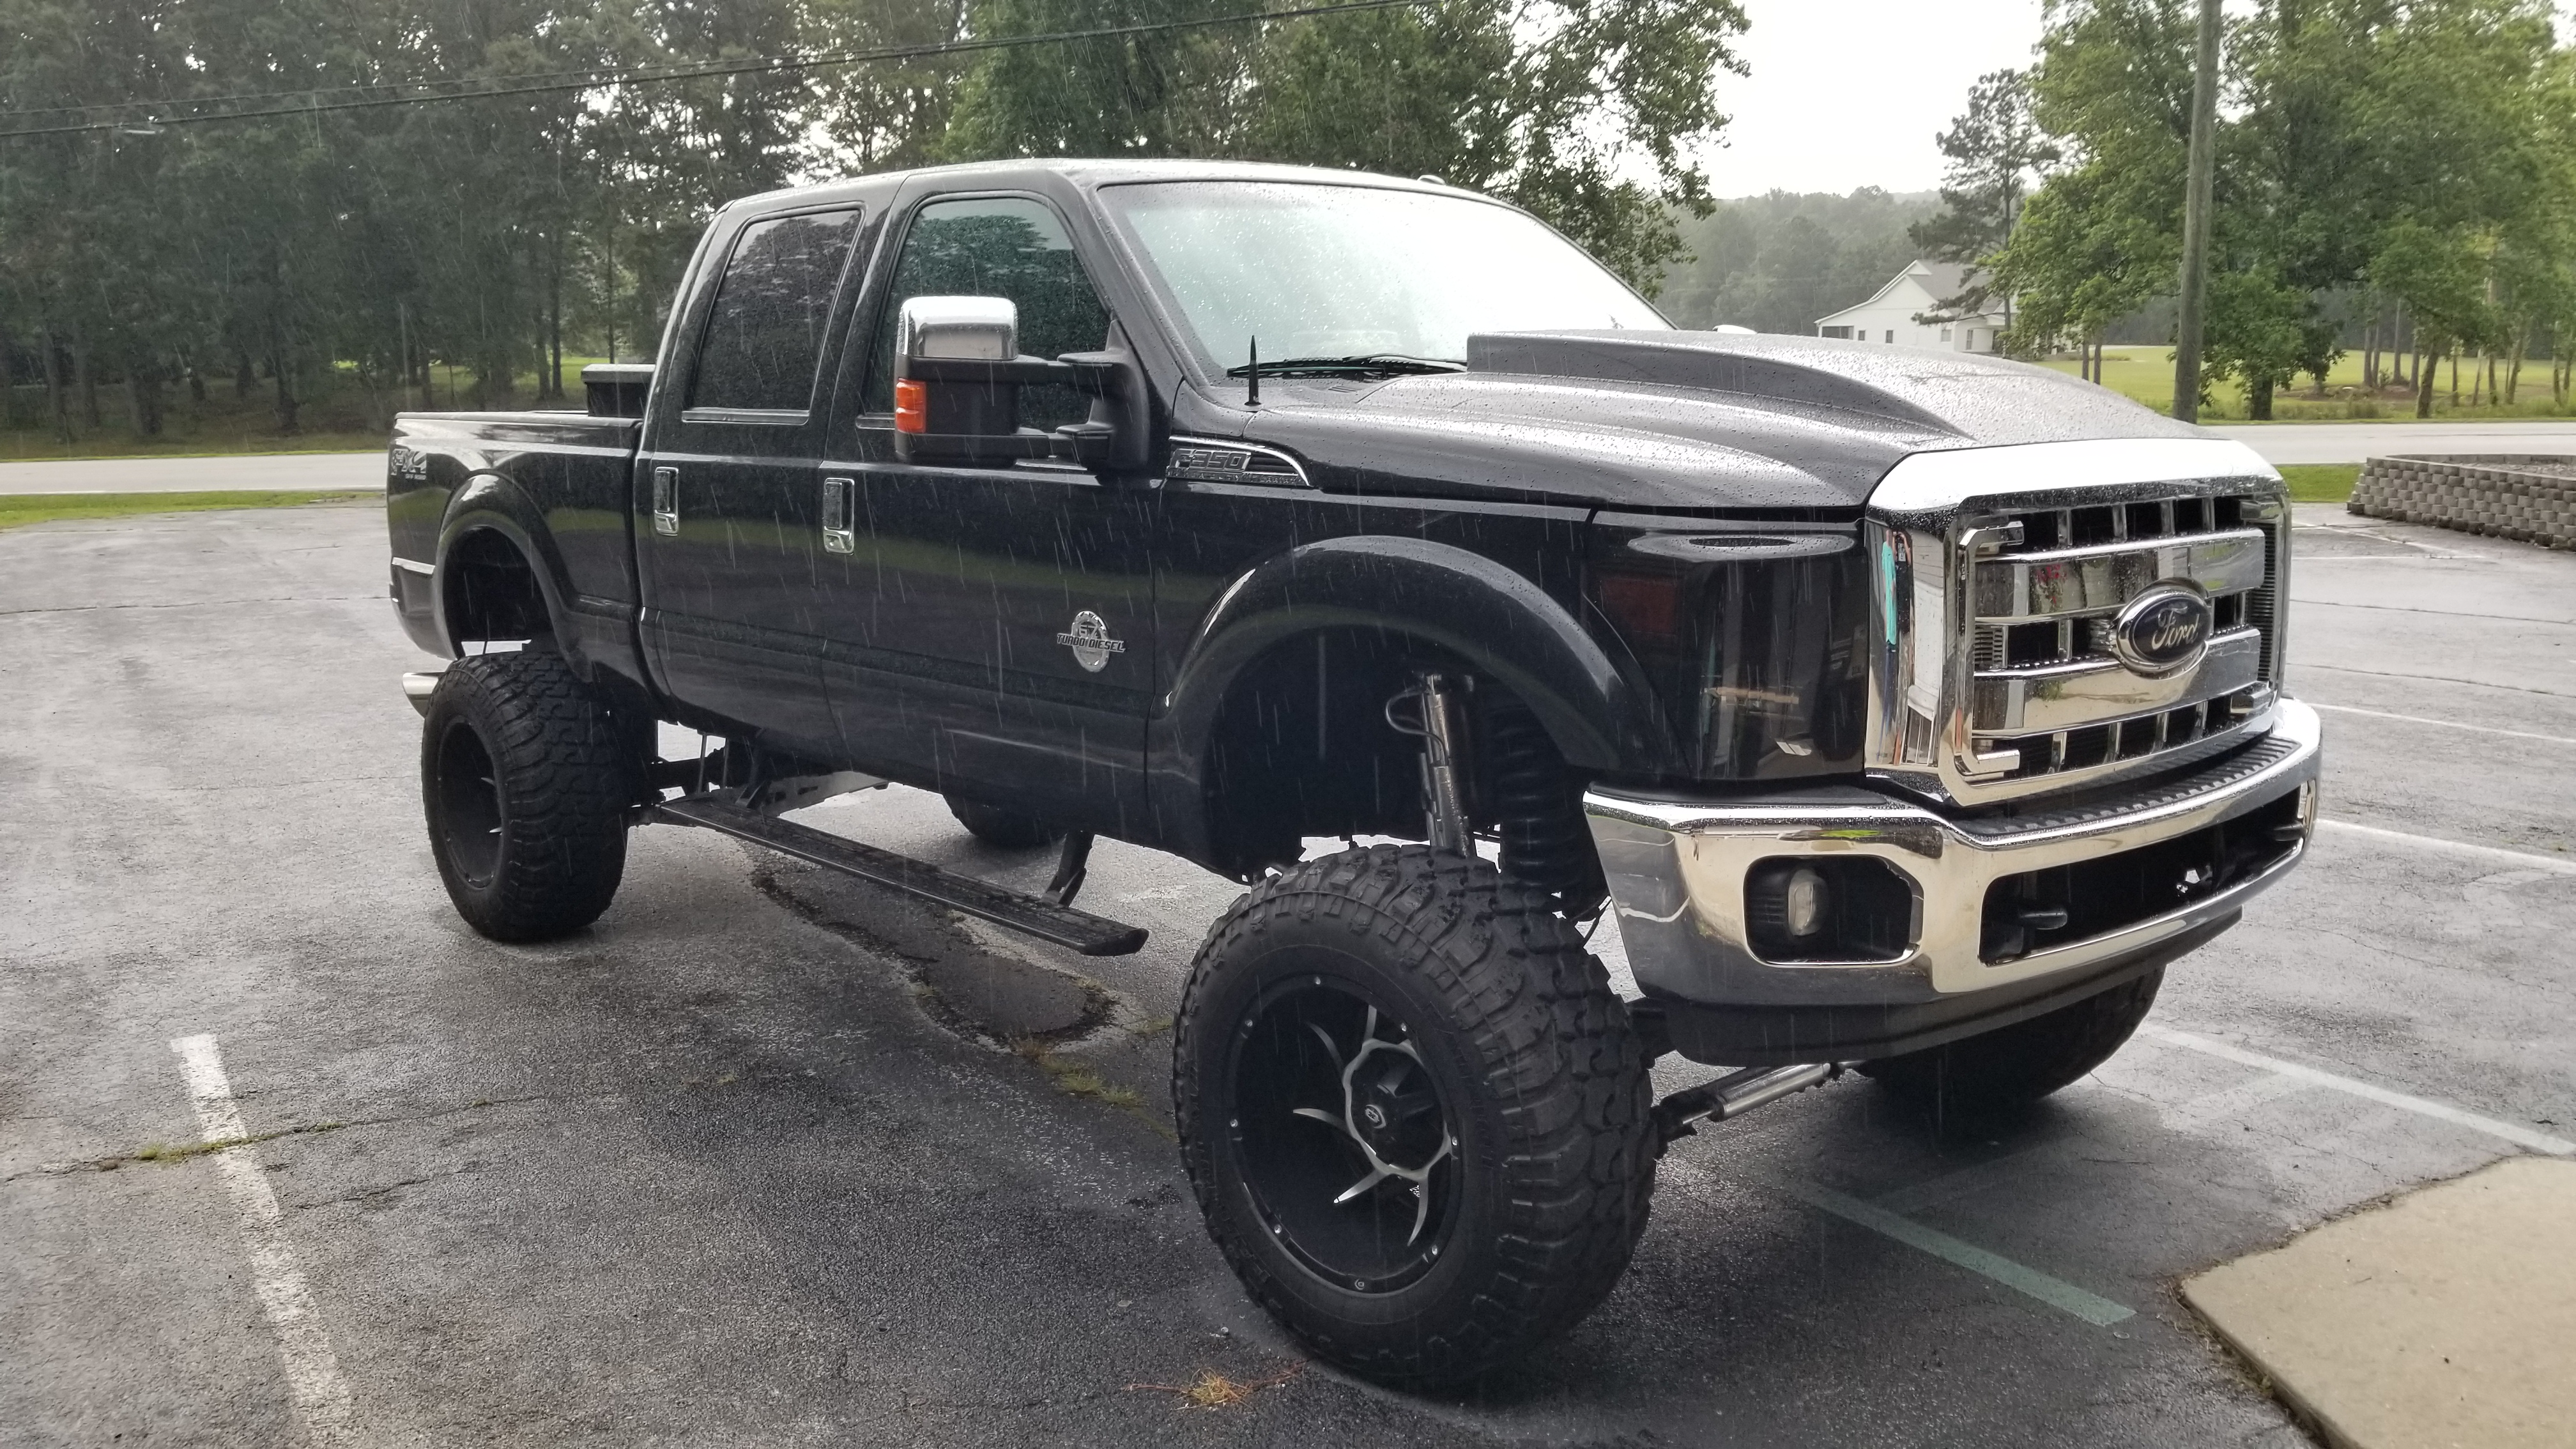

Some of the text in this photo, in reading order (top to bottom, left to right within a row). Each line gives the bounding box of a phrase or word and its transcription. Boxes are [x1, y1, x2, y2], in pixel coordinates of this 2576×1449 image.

[2151, 602, 2200, 650] Ford
[1057, 634, 1125, 652] TURBO DIESEL
